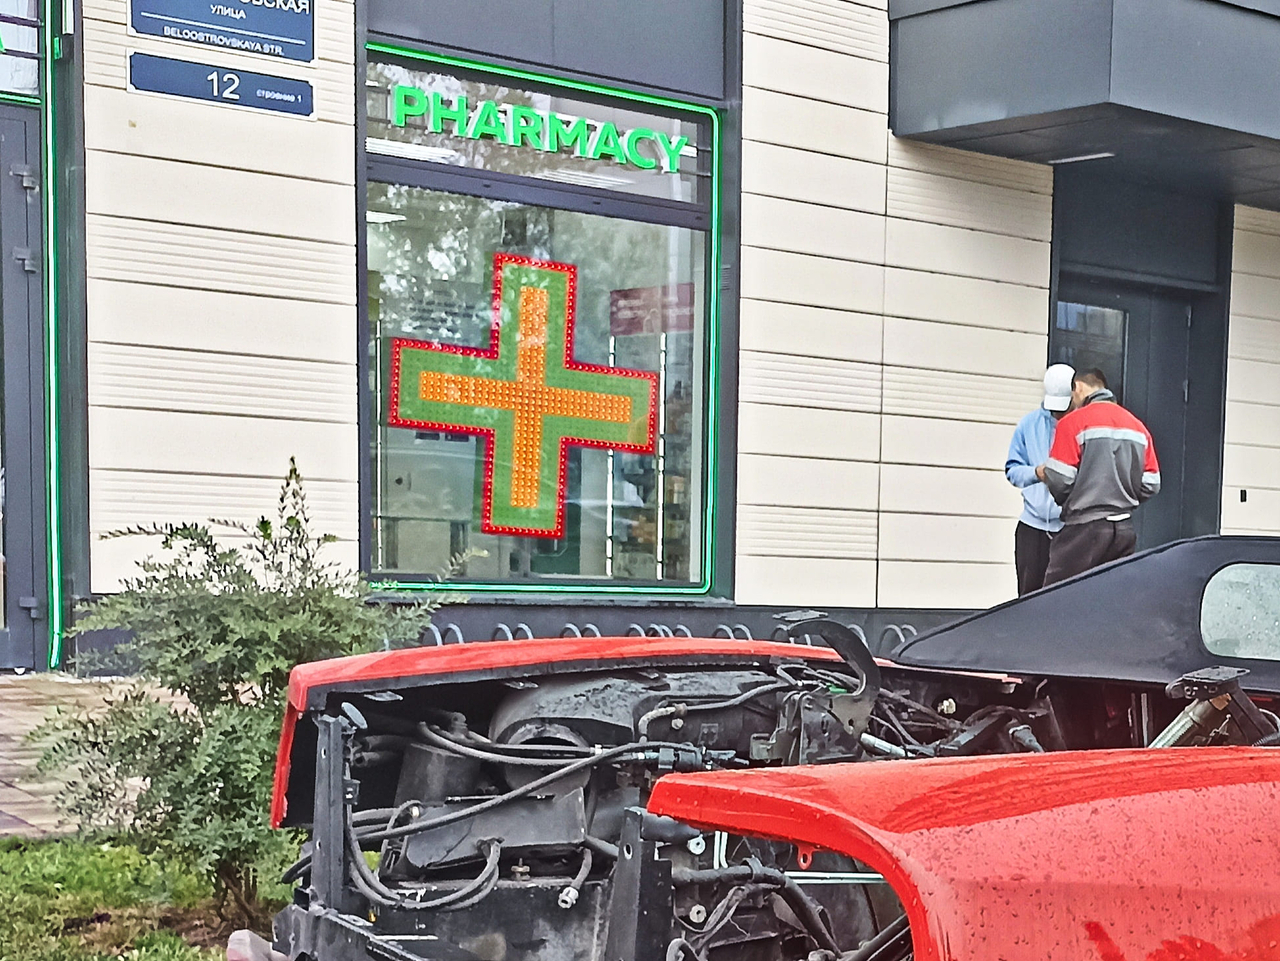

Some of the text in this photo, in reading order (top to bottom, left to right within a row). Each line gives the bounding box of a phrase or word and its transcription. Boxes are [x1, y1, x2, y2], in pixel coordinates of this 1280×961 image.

[210, 4, 247, 20] УЛИЦА
[163, 26, 285, 56] BELOOSTROVSKAYA STR.
[206, 71, 240, 100] 12
[297, 94, 302, 103] 1
[391, 84, 689, 173] PHARMACY
